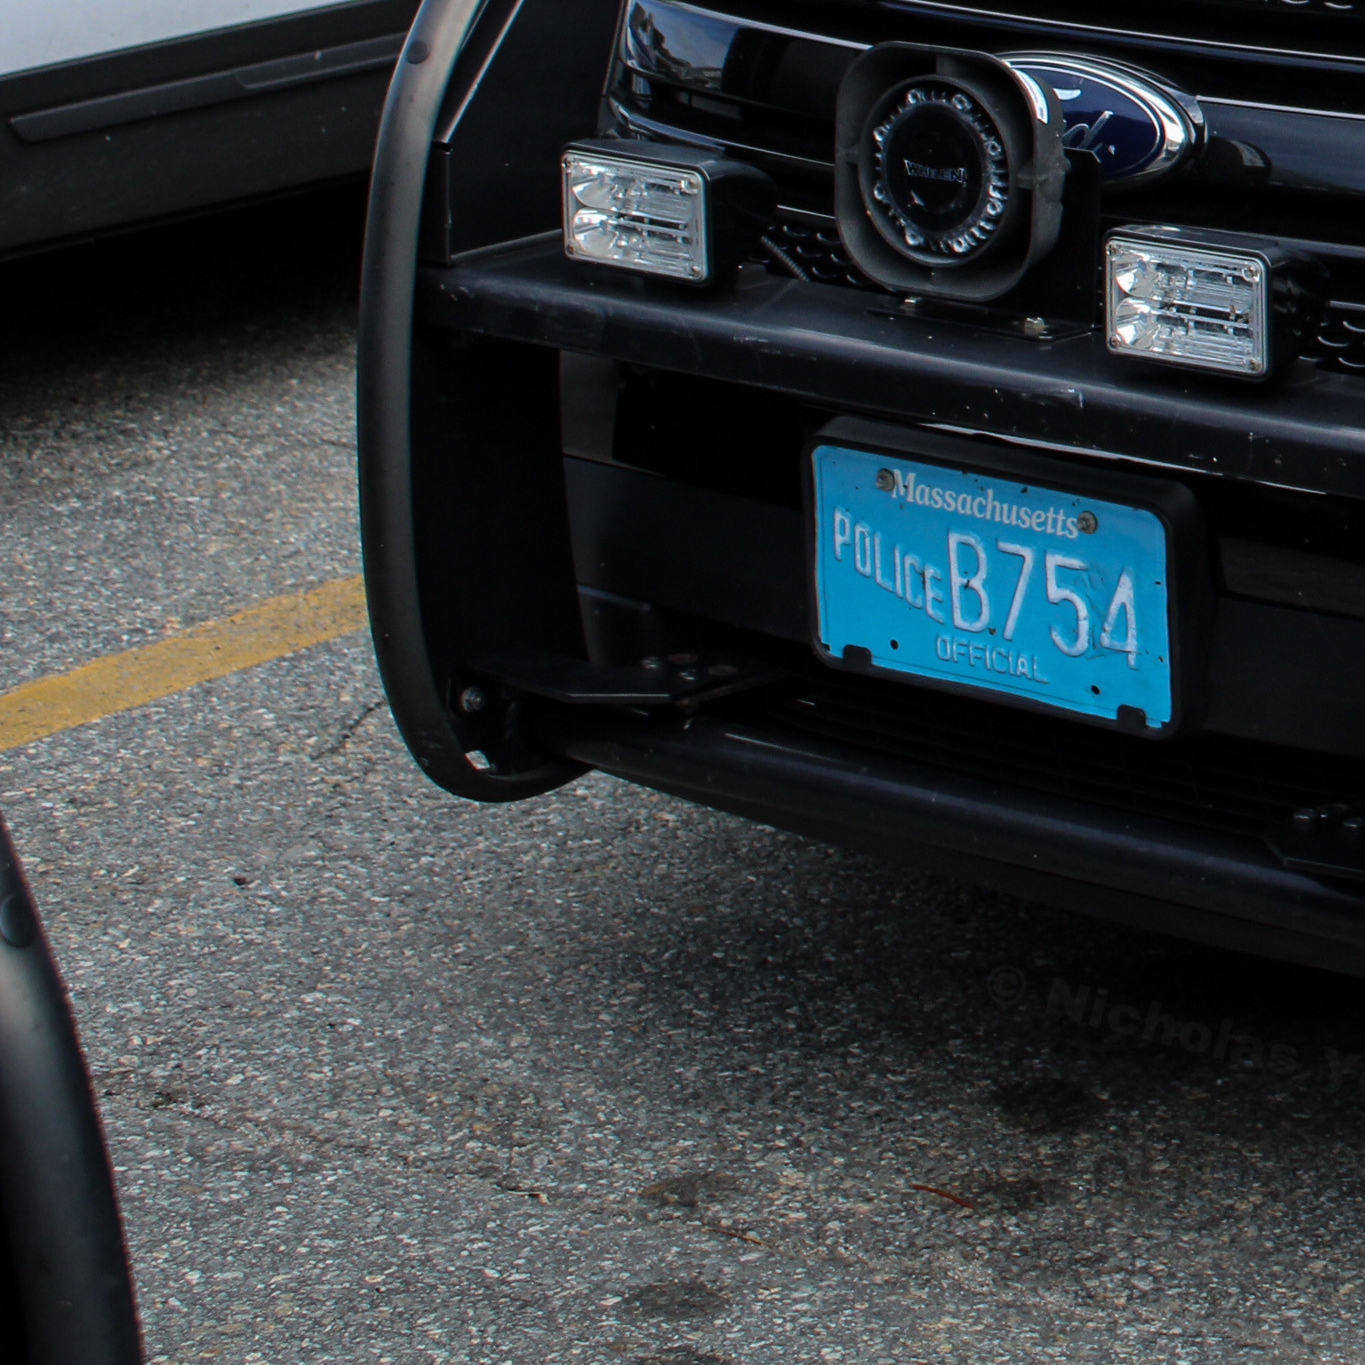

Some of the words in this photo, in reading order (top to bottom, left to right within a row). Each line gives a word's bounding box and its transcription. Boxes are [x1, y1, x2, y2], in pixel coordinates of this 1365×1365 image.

[891, 468, 1080, 539] Massachusetts
[832, 505, 945, 624] POLICE
[947, 526, 1139, 671] B754
[936, 633, 1050, 684] OFFICIAL
